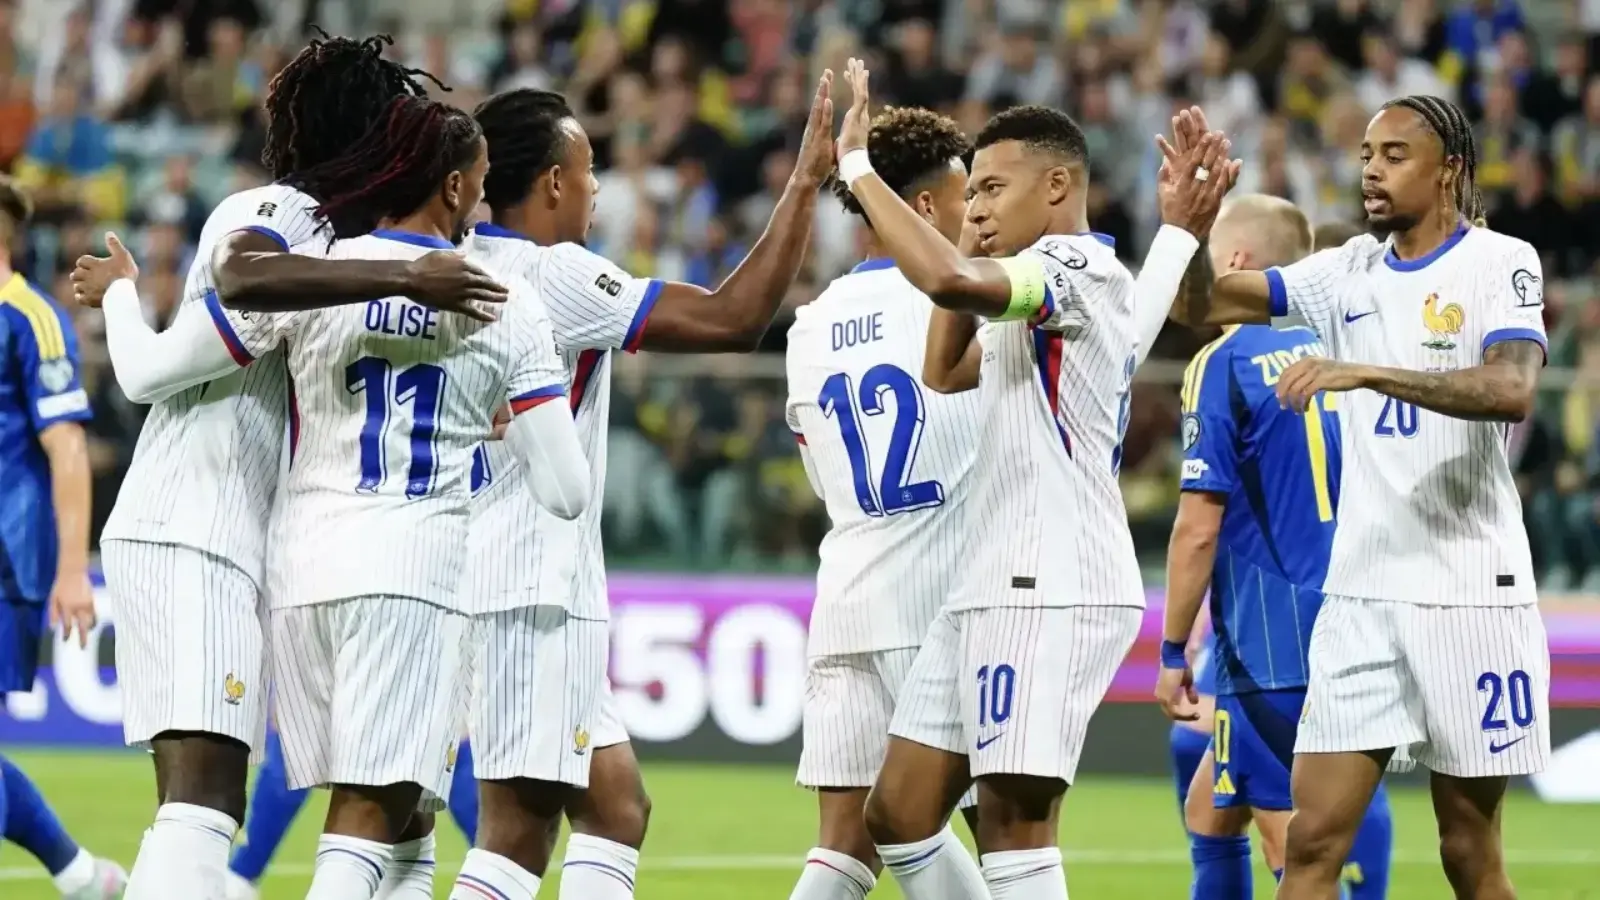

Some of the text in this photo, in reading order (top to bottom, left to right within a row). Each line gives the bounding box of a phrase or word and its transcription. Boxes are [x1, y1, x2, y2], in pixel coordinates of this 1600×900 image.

[365, 300, 439, 340] OLISE
[832, 312, 883, 352] DOUE
[346, 356, 447, 500] 11
[818, 364, 945, 517] 12
[1375, 392, 1420, 439] 20
[977, 664, 1016, 728] 10
[1477, 670, 1536, 732] 20
